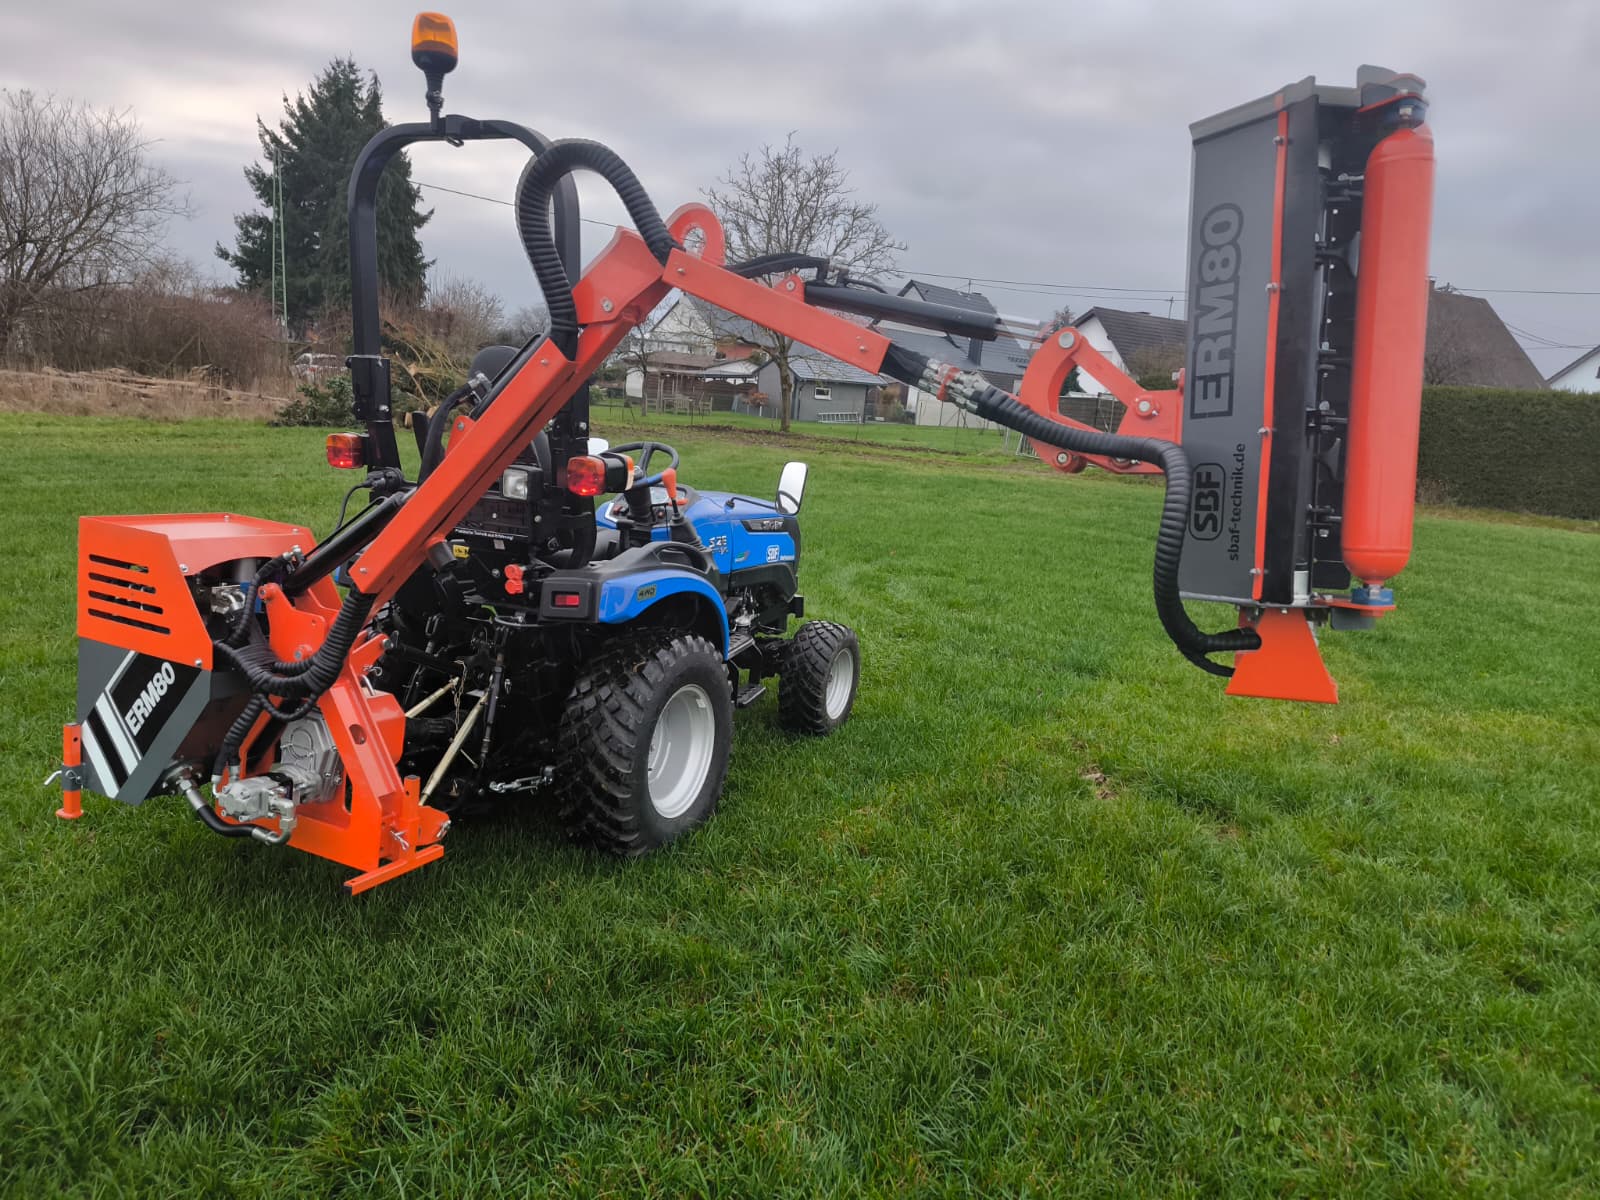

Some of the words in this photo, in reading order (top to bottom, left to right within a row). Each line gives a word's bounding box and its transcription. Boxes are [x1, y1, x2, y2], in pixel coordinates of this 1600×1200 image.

[1191, 204, 1242, 418] ERM80
[1193, 471, 1221, 533] SBF
[1227, 443, 1246, 561] sbaf-technik.de
[125, 662, 175, 736] ERM80
